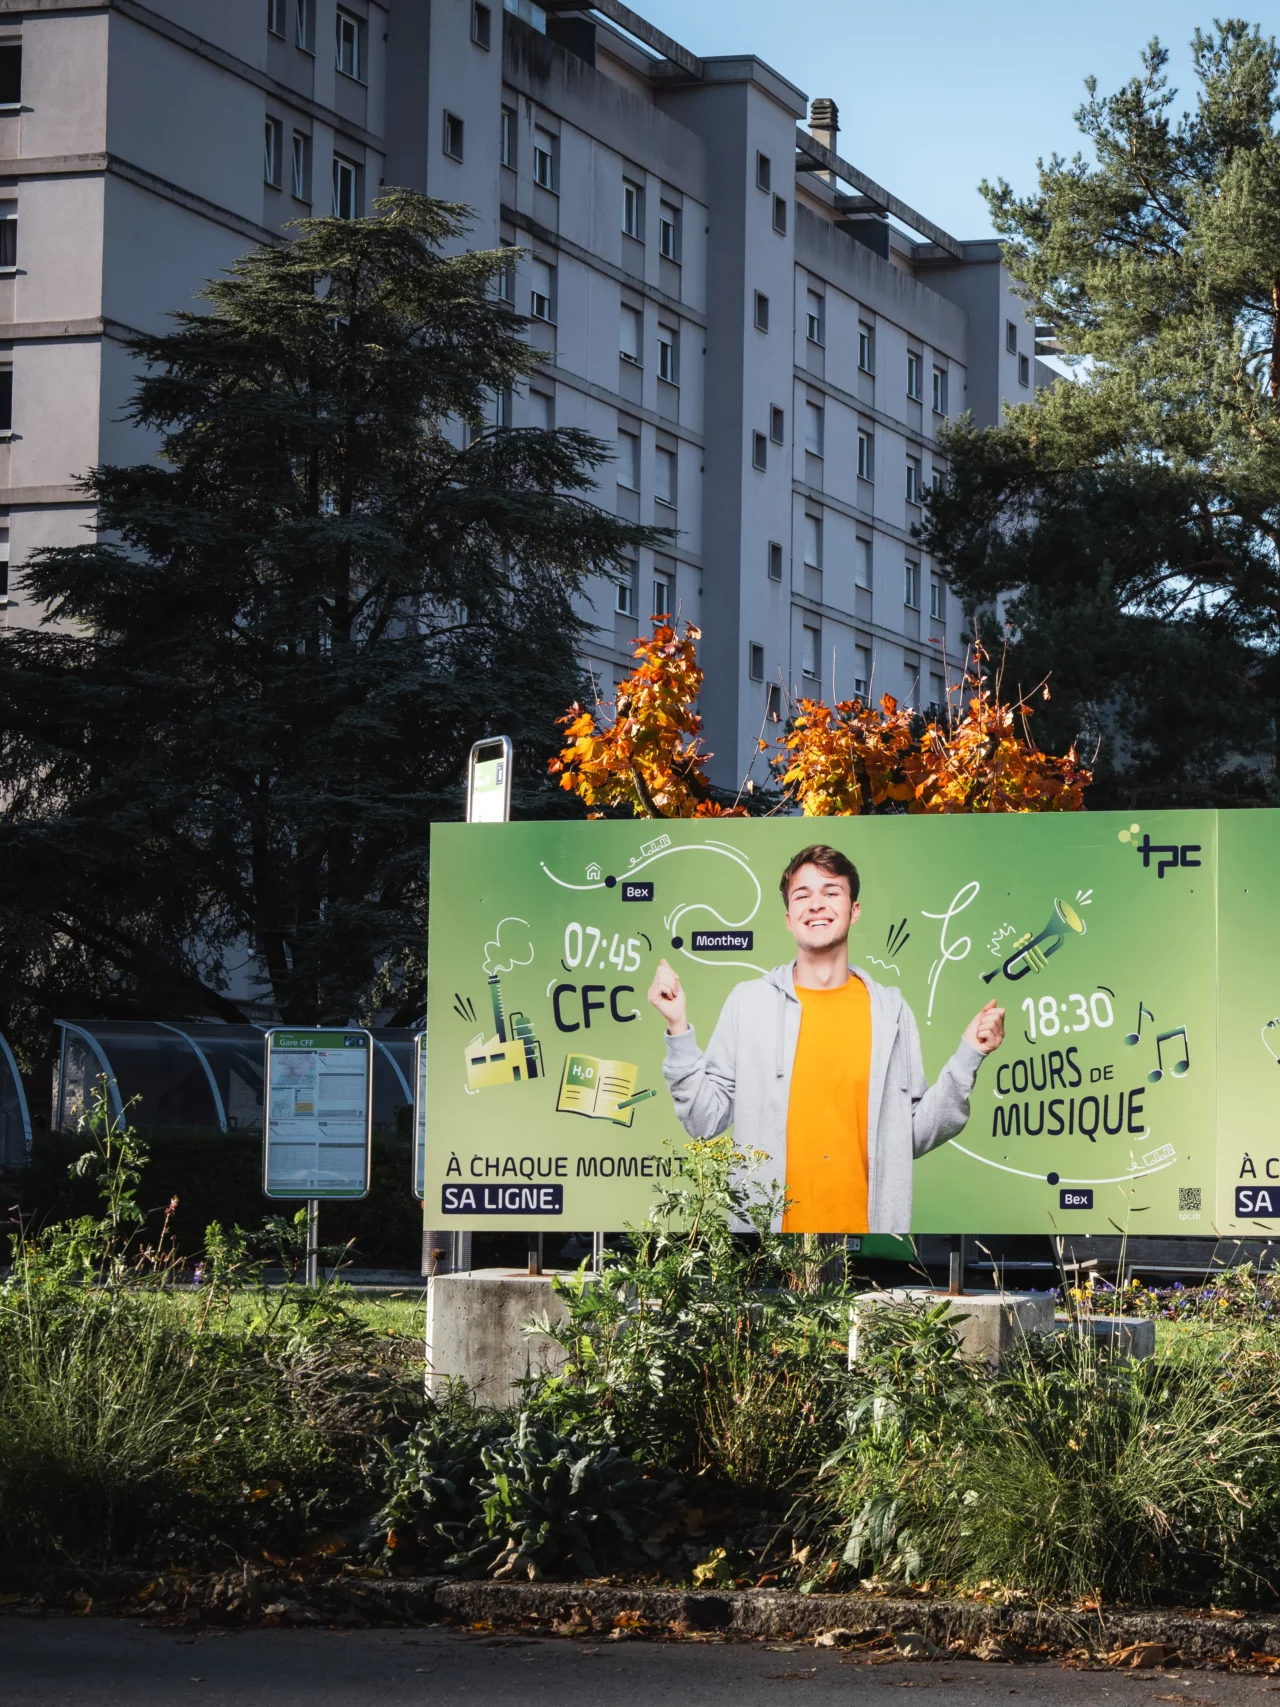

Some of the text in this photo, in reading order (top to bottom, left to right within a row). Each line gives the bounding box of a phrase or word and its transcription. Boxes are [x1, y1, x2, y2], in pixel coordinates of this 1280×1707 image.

[1137, 834, 1201, 878] tpc
[626, 886, 649, 897] Bex
[564, 922, 641, 972] 07:45
[696, 935, 749, 948] Monthey
[552, 984, 636, 1033] CFC
[1022, 992, 1114, 1039] 18:30
[996, 1047, 1114, 1095] COURS DE
[991, 1087, 1145, 1142] MUSIQUE
[446, 1151, 462, 1177] À
[470, 1156, 567, 1181] CHAQUE
[1239, 1152, 1256, 1178] À
[445, 1188, 560, 1210] SA LIGNE.
[1064, 1193, 1088, 1205] Bex
[1238, 1190, 1272, 1212] SA
[1179, 1212, 1201, 1220] tpc.ch
